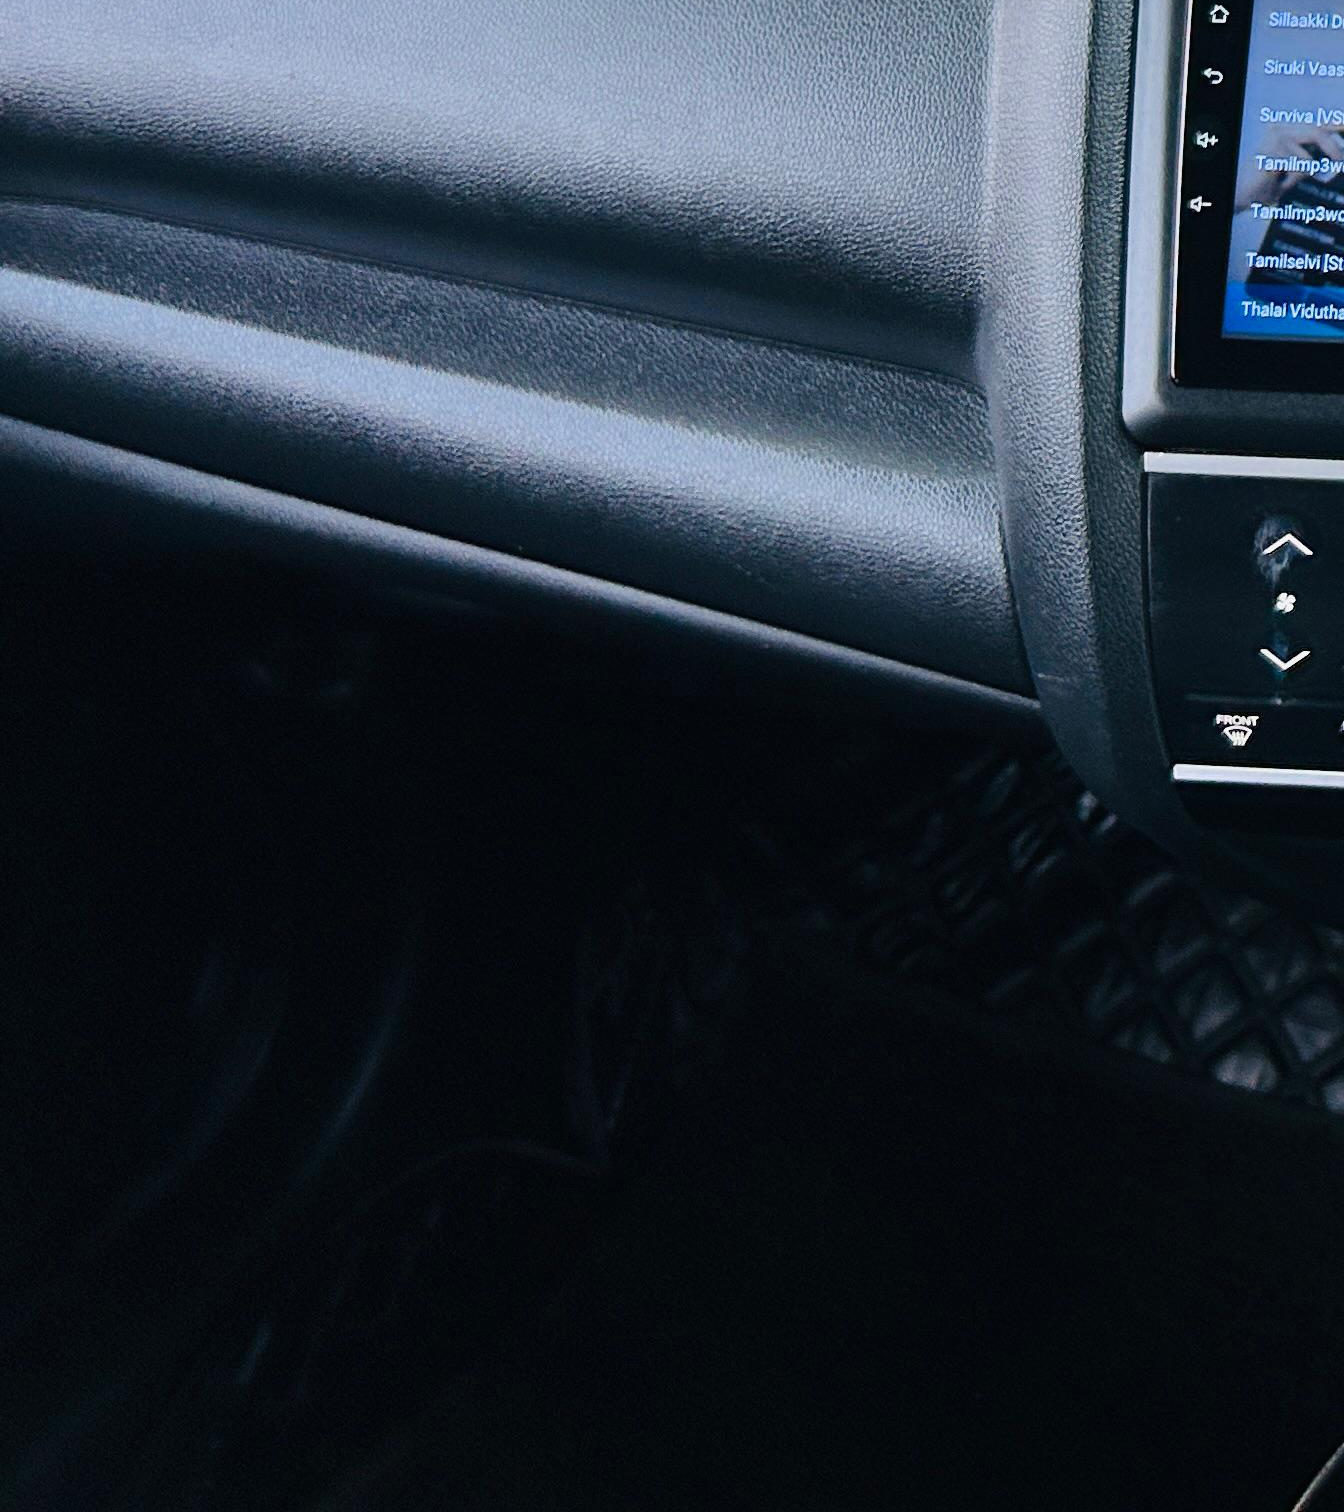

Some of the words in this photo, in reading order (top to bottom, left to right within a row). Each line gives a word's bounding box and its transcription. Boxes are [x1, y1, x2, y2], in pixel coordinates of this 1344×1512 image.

[1269, 13, 1328, 29] Sillaakki
[1264, 60, 1305, 77] Siruki
[1260, 107, 1314, 124] Surviva
[1246, 252, 1321, 271] Tamilselvi
[1241, 300, 1288, 319] Thalai
[1215, 714, 1259, 727] FRONT
